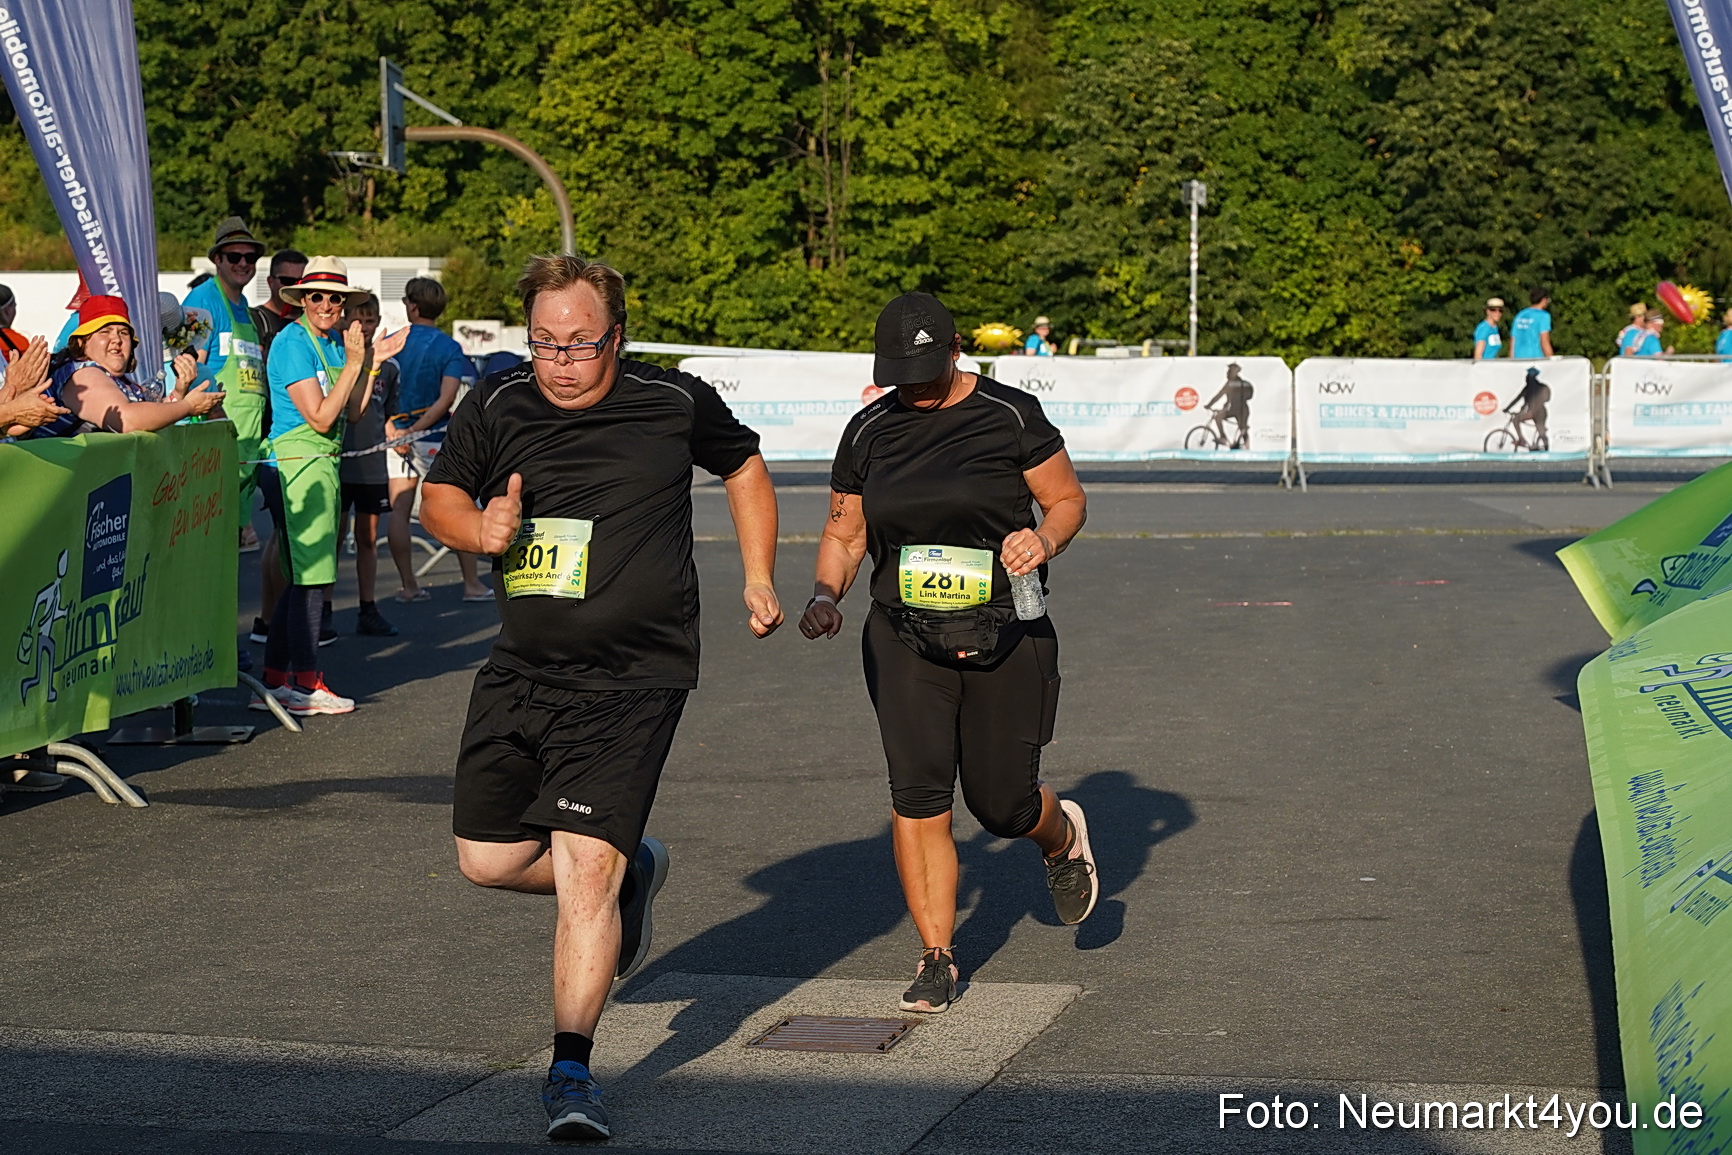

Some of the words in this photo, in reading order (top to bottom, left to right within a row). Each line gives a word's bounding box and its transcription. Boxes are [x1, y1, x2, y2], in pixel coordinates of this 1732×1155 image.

[914, 337, 933, 346] adidas
[710, 379, 741, 393] OW
[1019, 379, 1056, 392] NOW
[1318, 382, 1355, 394] NOW
[1635, 381, 1673, 395] NOW
[1377, 406, 1388, 418] &
[91, 513, 127, 542] Fischer
[92, 532, 126, 551] AUTOMOBILE
[515, 544, 558, 570] 301
[904, 569, 913, 599] WALK
[922, 570, 966, 591] 281
[919, 590, 937, 599] Link
[939, 591, 971, 600] Martina
[978, 574, 987, 602] 202
[568, 802, 592, 815] JAKO
